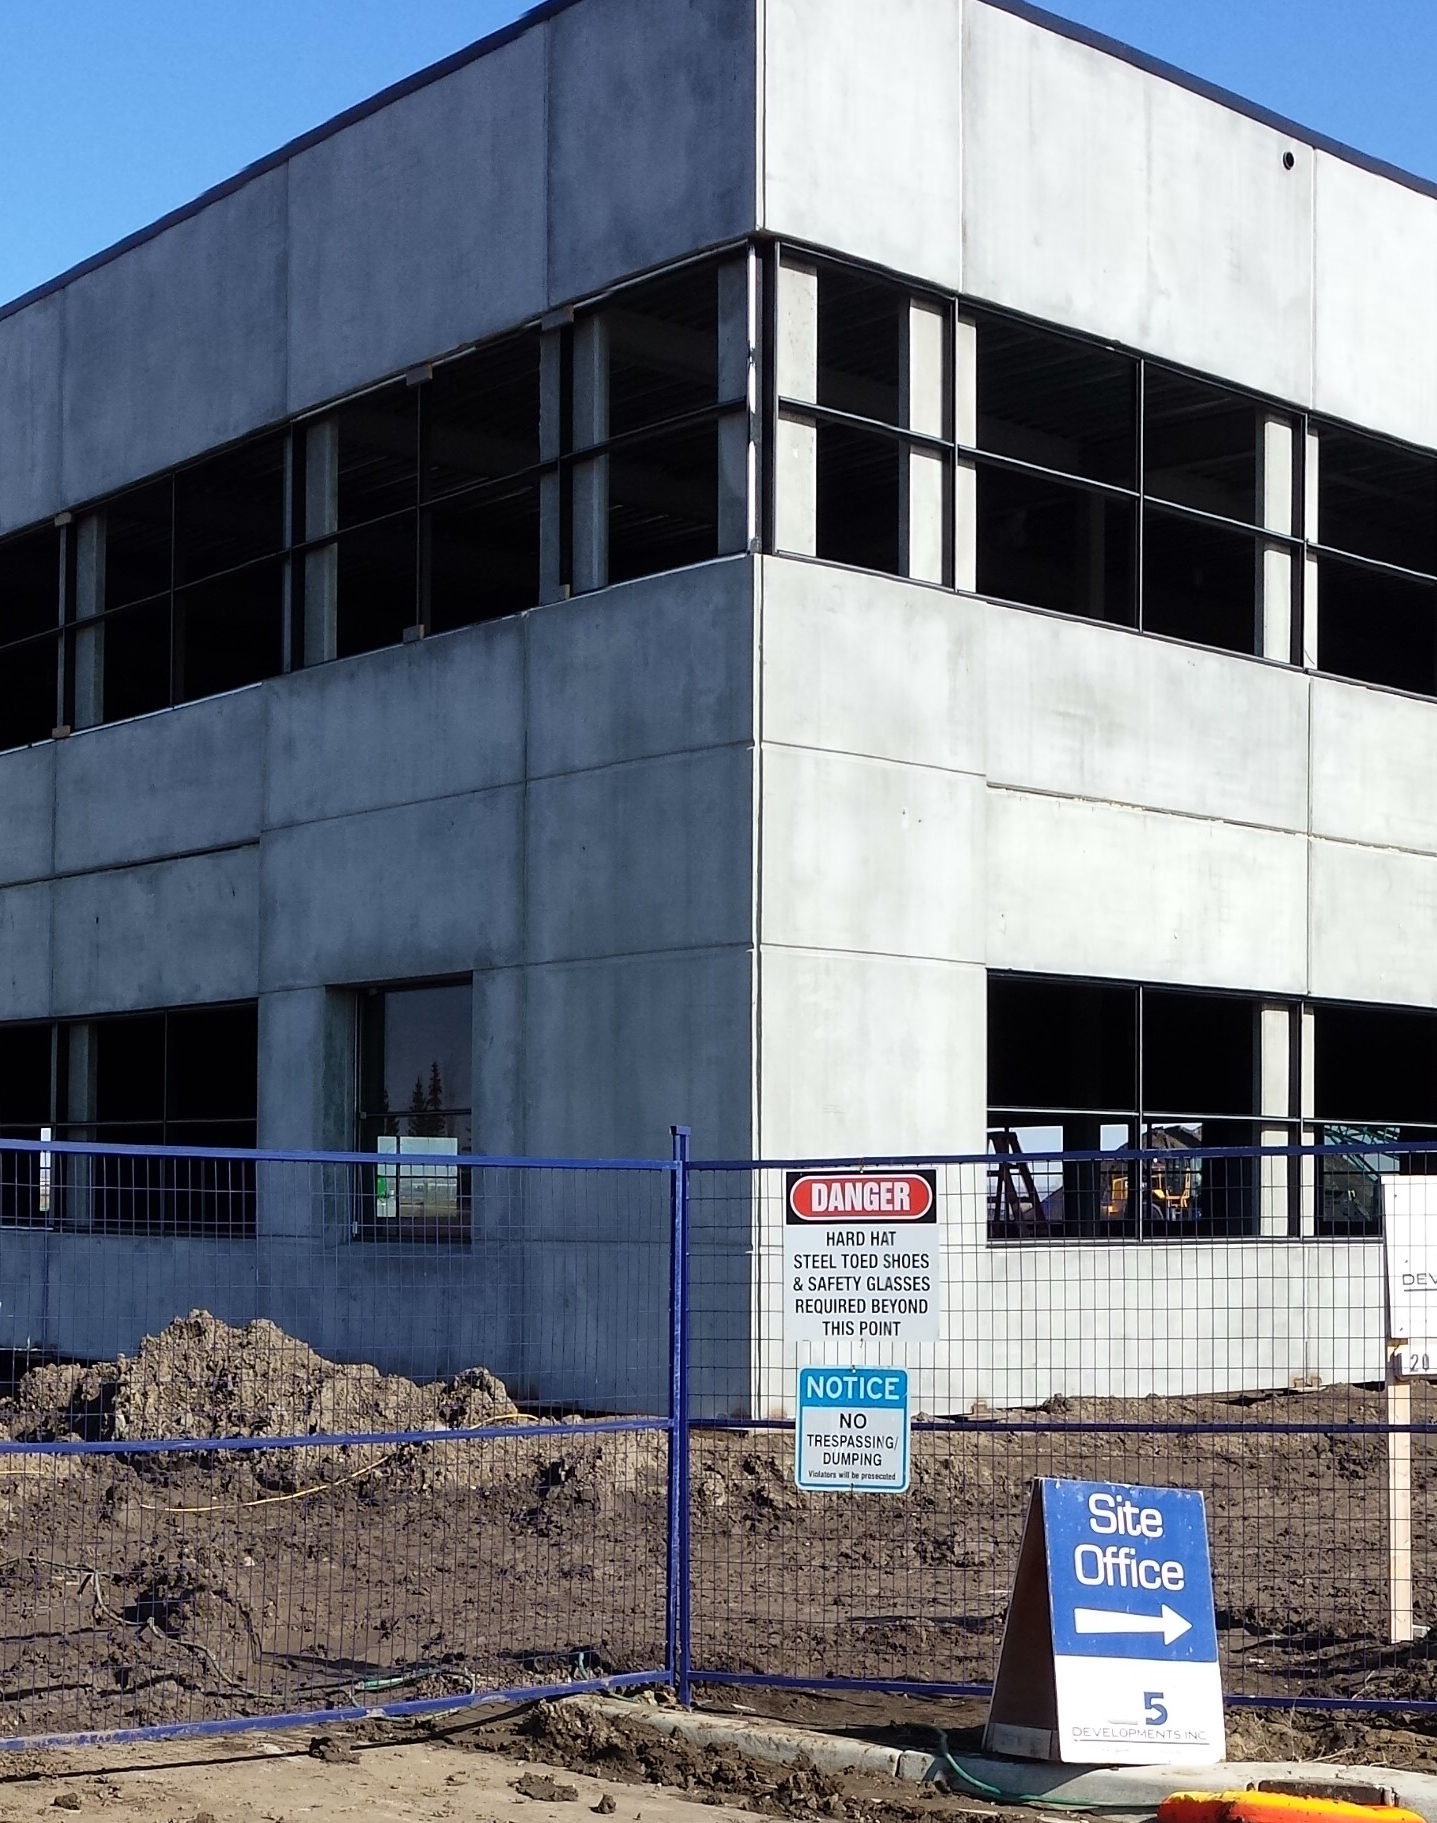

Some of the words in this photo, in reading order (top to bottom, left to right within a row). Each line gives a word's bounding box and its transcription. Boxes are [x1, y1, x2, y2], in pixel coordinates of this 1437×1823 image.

[812, 1182, 910, 1211] DANGER
[826, 1231, 865, 1246] HARD
[871, 1231, 896, 1246] HAT
[794, 1254, 837, 1269] STEEL
[841, 1254, 878, 1268] TOED
[883, 1254, 929, 1268] SHOES
[793, 1277, 803, 1291] &
[808, 1277, 861, 1291] SAFETY
[867, 1276, 930, 1291] GLASSES
[795, 1299, 865, 1314] REQUIRED
[872, 1299, 928, 1313] BEYOND
[822, 1321, 854, 1336] THIS
[860, 1321, 901, 1336] POINT
[1410, 1353, 1429, 1372] 20
[807, 1376, 899, 1400] NOTICE
[840, 1413, 867, 1429] NO
[807, 1434, 898, 1450] TRESPASSING/
[823, 1452, 882, 1466] DUMPING
[808, 1470, 836, 1479] Violators
[839, 1471, 849, 1479] will
[1088, 1492, 1163, 1538] Site
[1074, 1544, 1184, 1591] Office
[1072, 1727, 1181, 1739] DEVELOPMENTS
